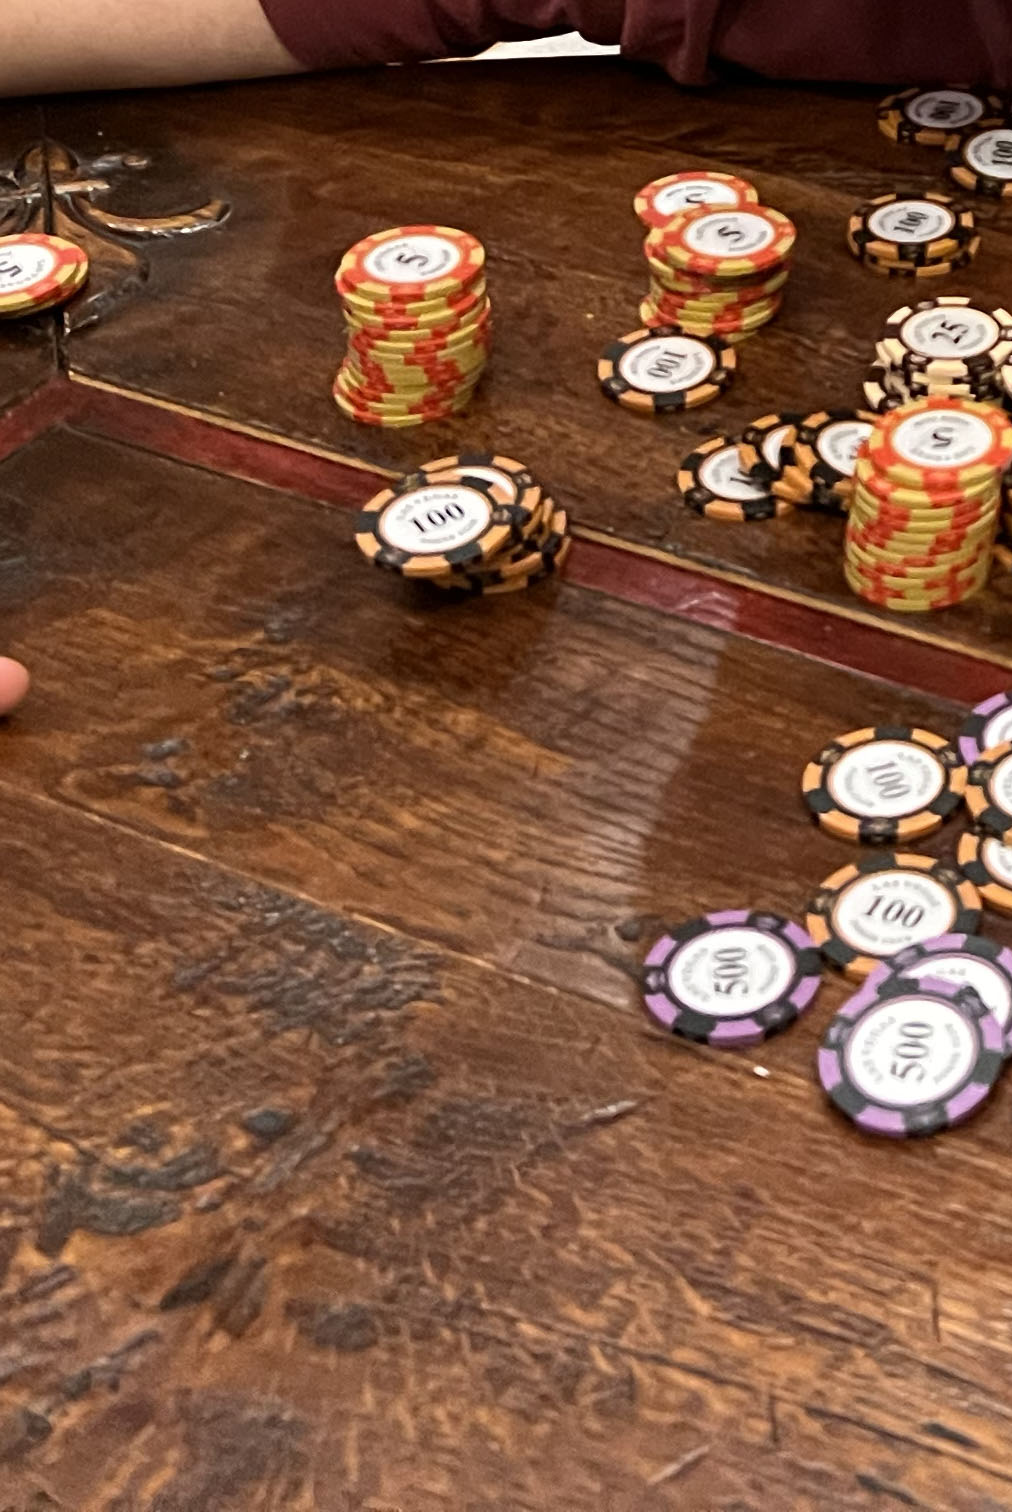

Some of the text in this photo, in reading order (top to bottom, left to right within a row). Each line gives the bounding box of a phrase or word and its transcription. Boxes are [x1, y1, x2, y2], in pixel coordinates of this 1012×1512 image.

[717, 225, 745, 243] 5
[894, 210, 928, 234] 100
[396, 252, 428, 268] 5
[931, 320, 970, 345] 25
[647, 350, 687, 379] 100
[932, 426, 954, 449] 5
[411, 502, 465, 534] 100
[866, 761, 911, 799] 100
[864, 894, 926, 929] 100
[714, 947, 749, 995] 500
[890, 1021, 934, 1084] 500
